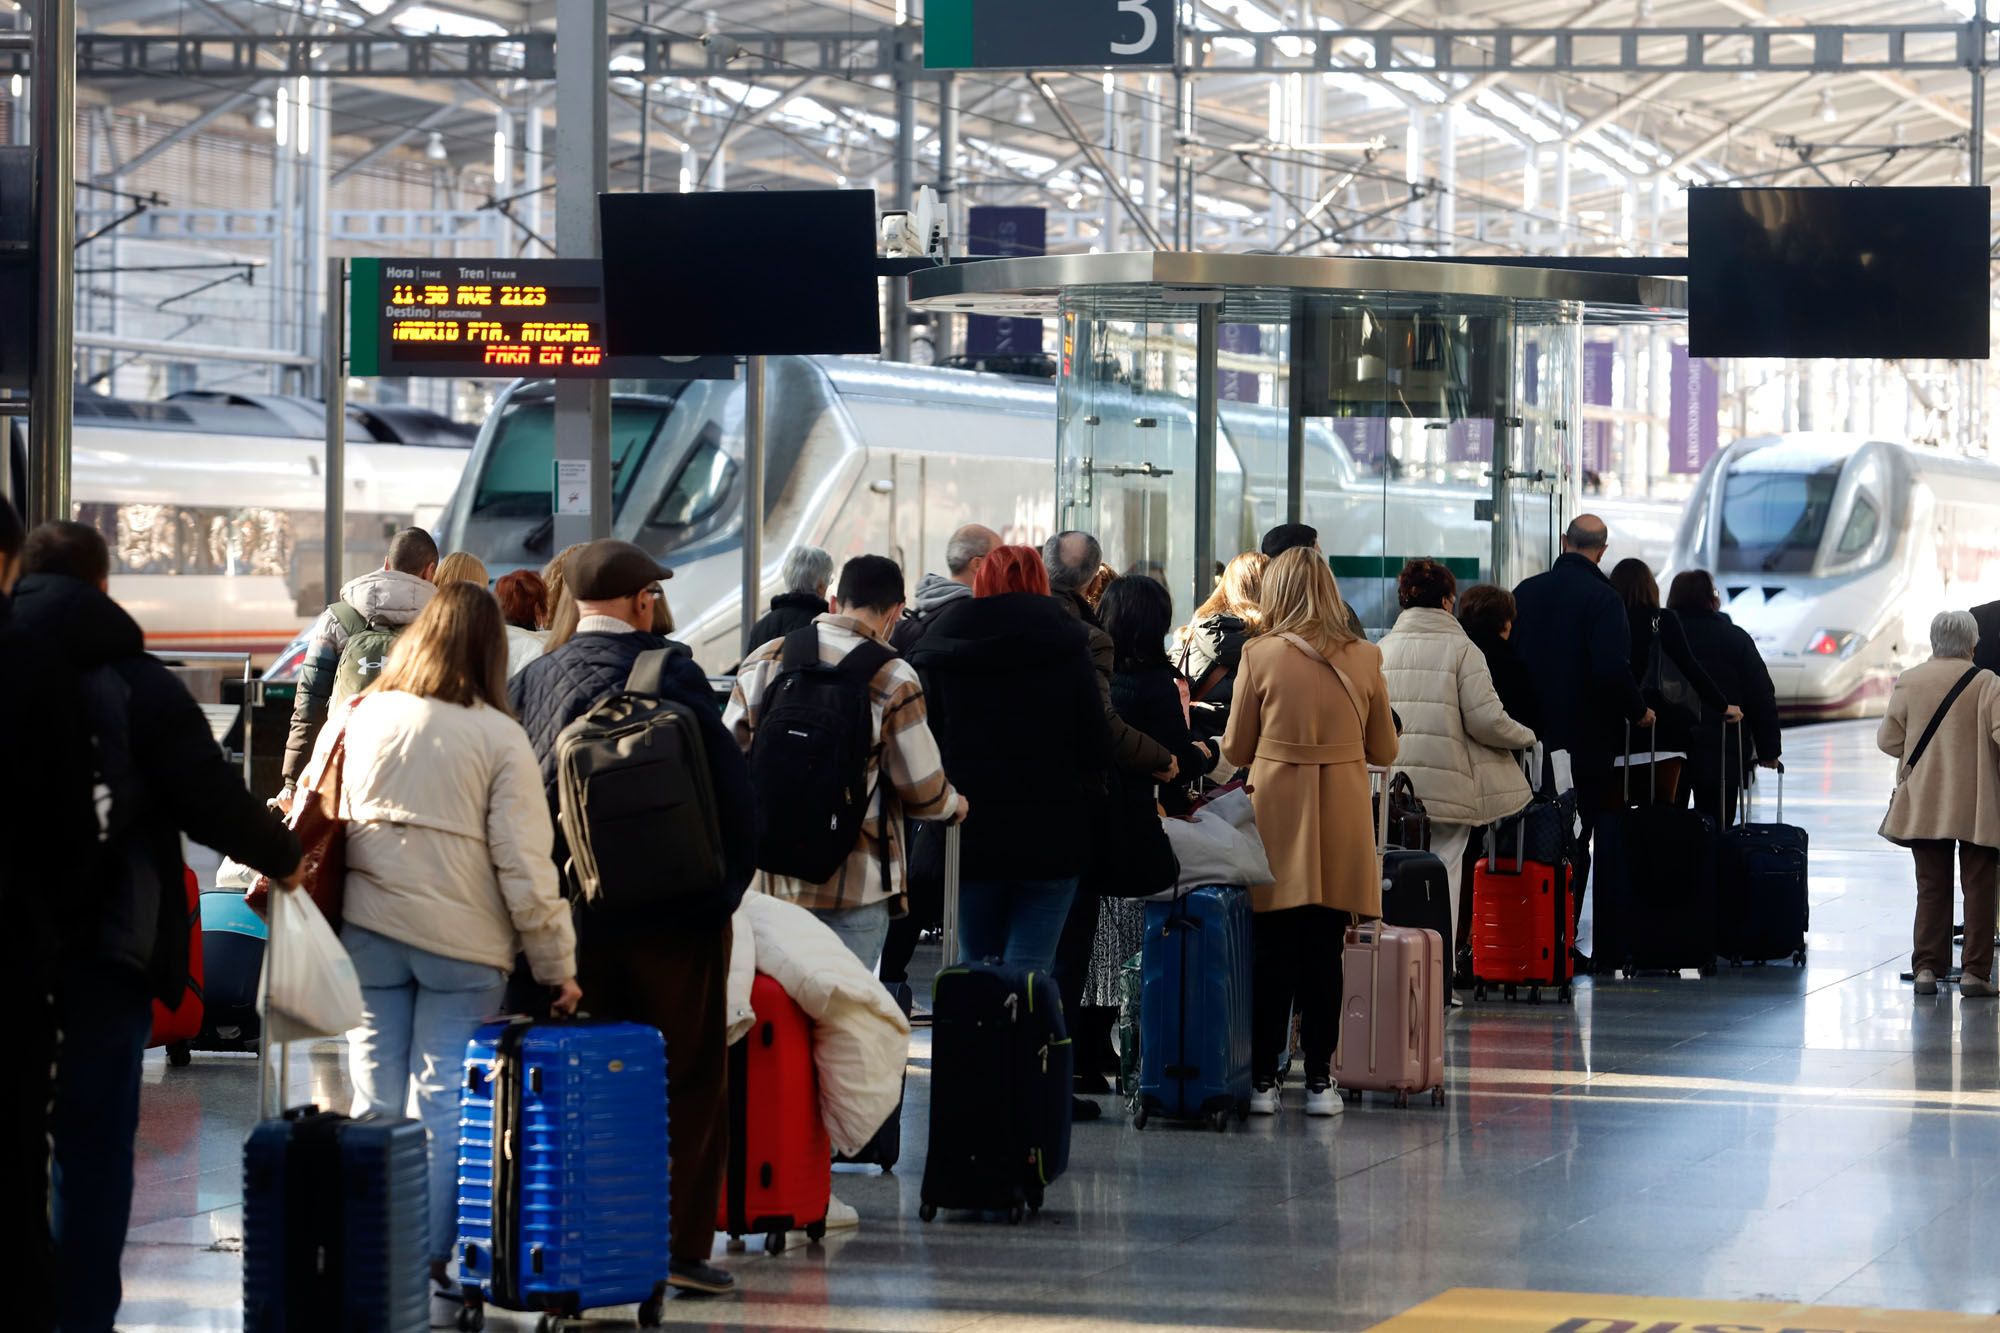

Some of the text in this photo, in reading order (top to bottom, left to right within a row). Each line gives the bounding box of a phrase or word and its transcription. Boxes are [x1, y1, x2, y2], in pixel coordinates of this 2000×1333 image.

[1110, 0, 1158, 55] 3
[386, 266, 442, 279] Hora TIME
[458, 267, 485, 279] Tren
[456, 285, 492, 305] AVE
[385, 305, 431, 318] Destino
[392, 320, 459, 341] MADRID
[521, 322, 590, 343] ATOCHA
[484, 345, 532, 364] PARA
